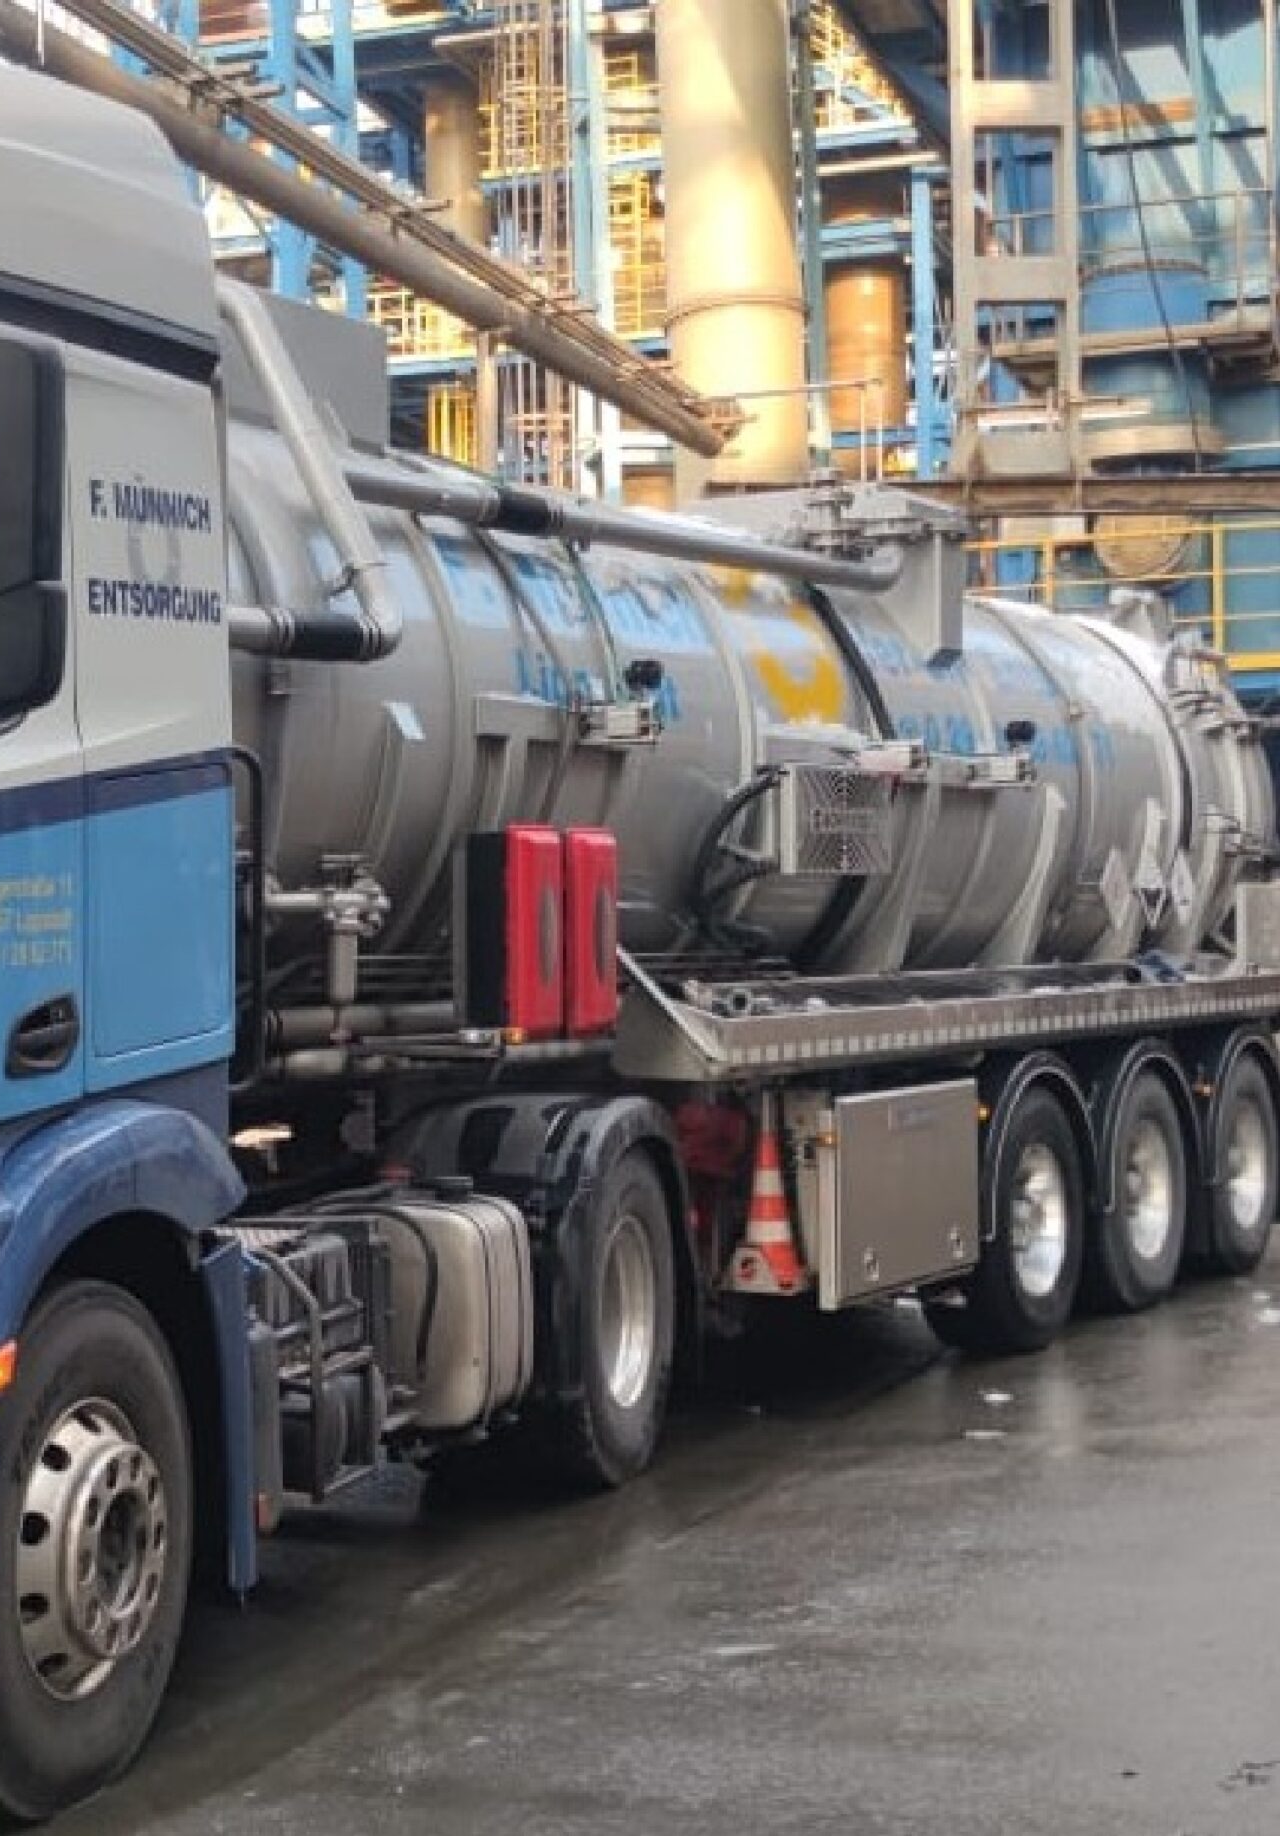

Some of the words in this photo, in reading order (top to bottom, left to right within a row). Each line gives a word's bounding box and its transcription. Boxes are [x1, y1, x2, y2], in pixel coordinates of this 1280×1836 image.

[89, 479, 108, 519] F.
[113, 474, 212, 534] MÜNNICH
[88, 577, 221, 624] ENTSORGUNG
